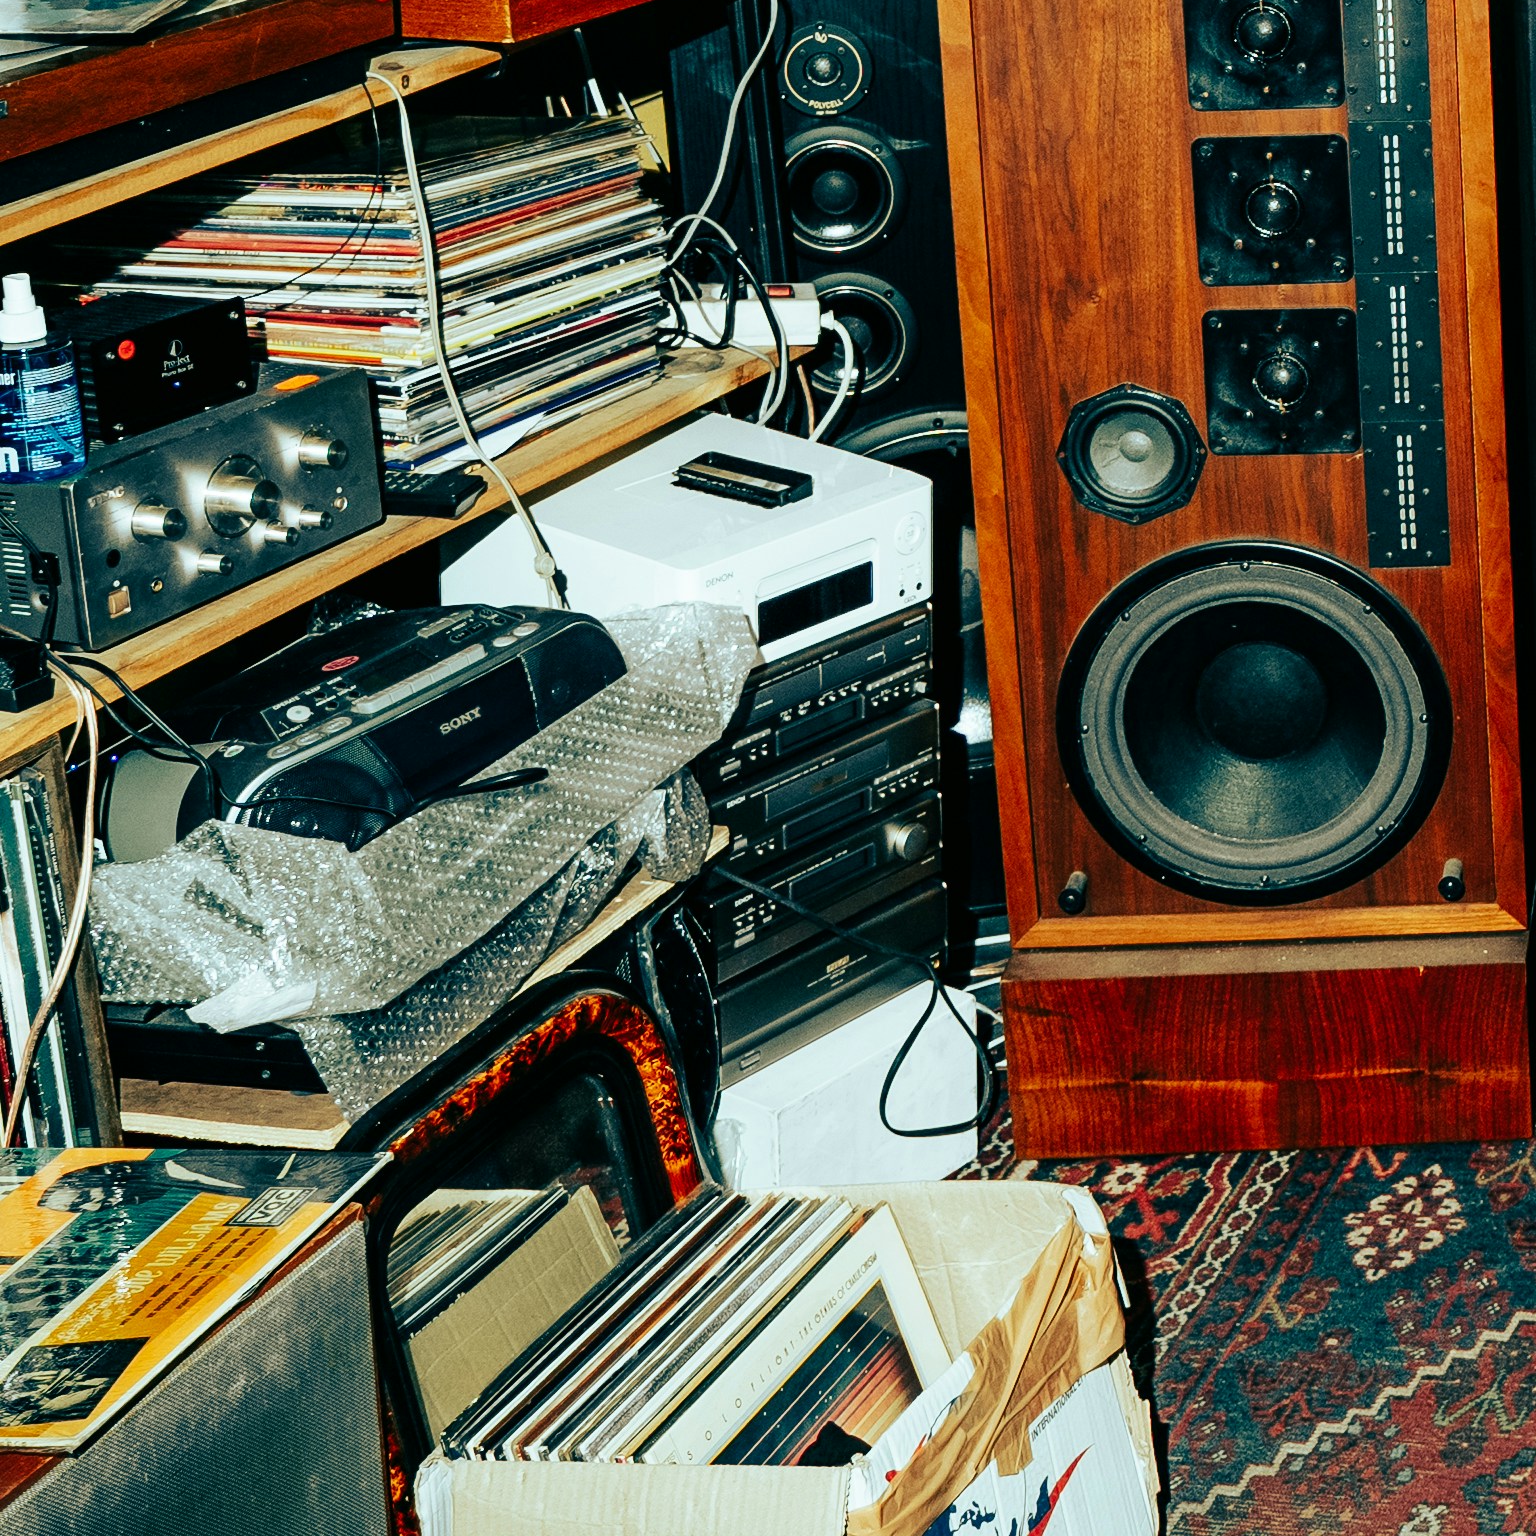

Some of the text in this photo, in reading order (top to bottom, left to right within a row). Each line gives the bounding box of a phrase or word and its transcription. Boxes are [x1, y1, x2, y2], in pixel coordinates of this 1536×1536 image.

[807, 99, 845, 111] POLYCELL
[163, 355, 190, 371] Pro-Ject
[705, 571, 734, 588] DENON
[439, 706, 482, 736] SONY
[726, 796, 746, 809] DENON
[734, 894, 753, 907] DENON
[248, 1190, 297, 1221] VQC
[155, 1202, 242, 1267] WILLIAMS
[687, 1398, 742, 1461] SOLO
[751, 1341, 796, 1393] FLIGHT
[798, 1322, 814, 1340] THE
[815, 1297, 838, 1324] GENIUS
[1031, 1383, 1078, 1442] INTERNATIONAL
